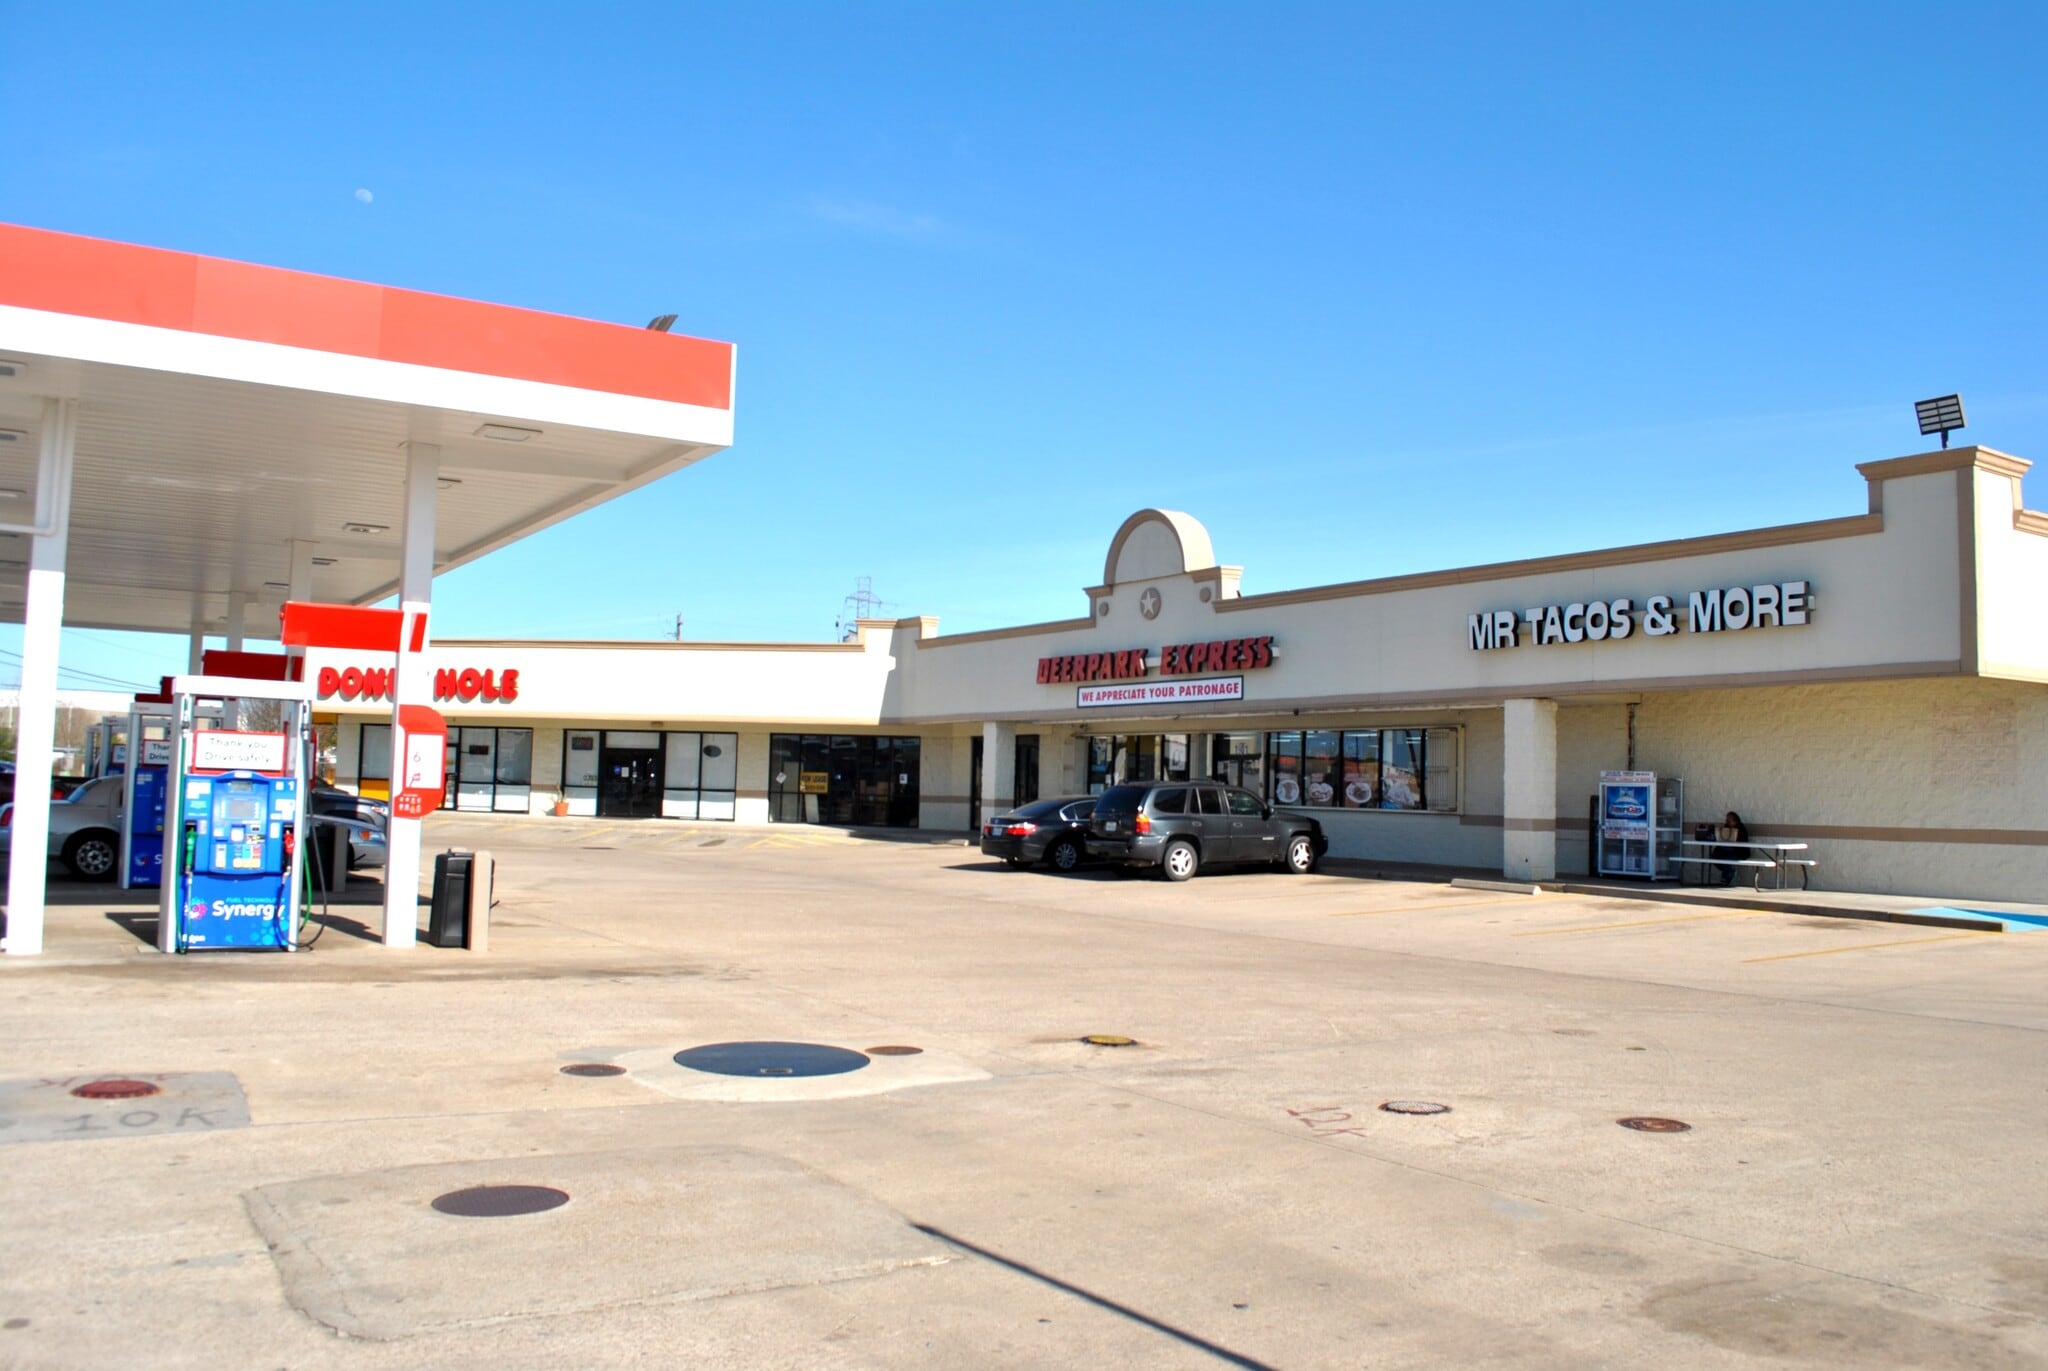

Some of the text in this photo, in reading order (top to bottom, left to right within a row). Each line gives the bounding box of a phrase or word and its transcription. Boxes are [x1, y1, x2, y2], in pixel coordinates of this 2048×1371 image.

[1468, 581, 1811, 650] MR TACOS & MORE
[1036, 636, 1274, 684] DEERPARK EXPRESS
[433, 668, 519, 704] HOLE
[1081, 682, 1239, 702] WE APPRECIATE YOUR PATRONAGE
[54, 1107, 227, 1134] 10K
